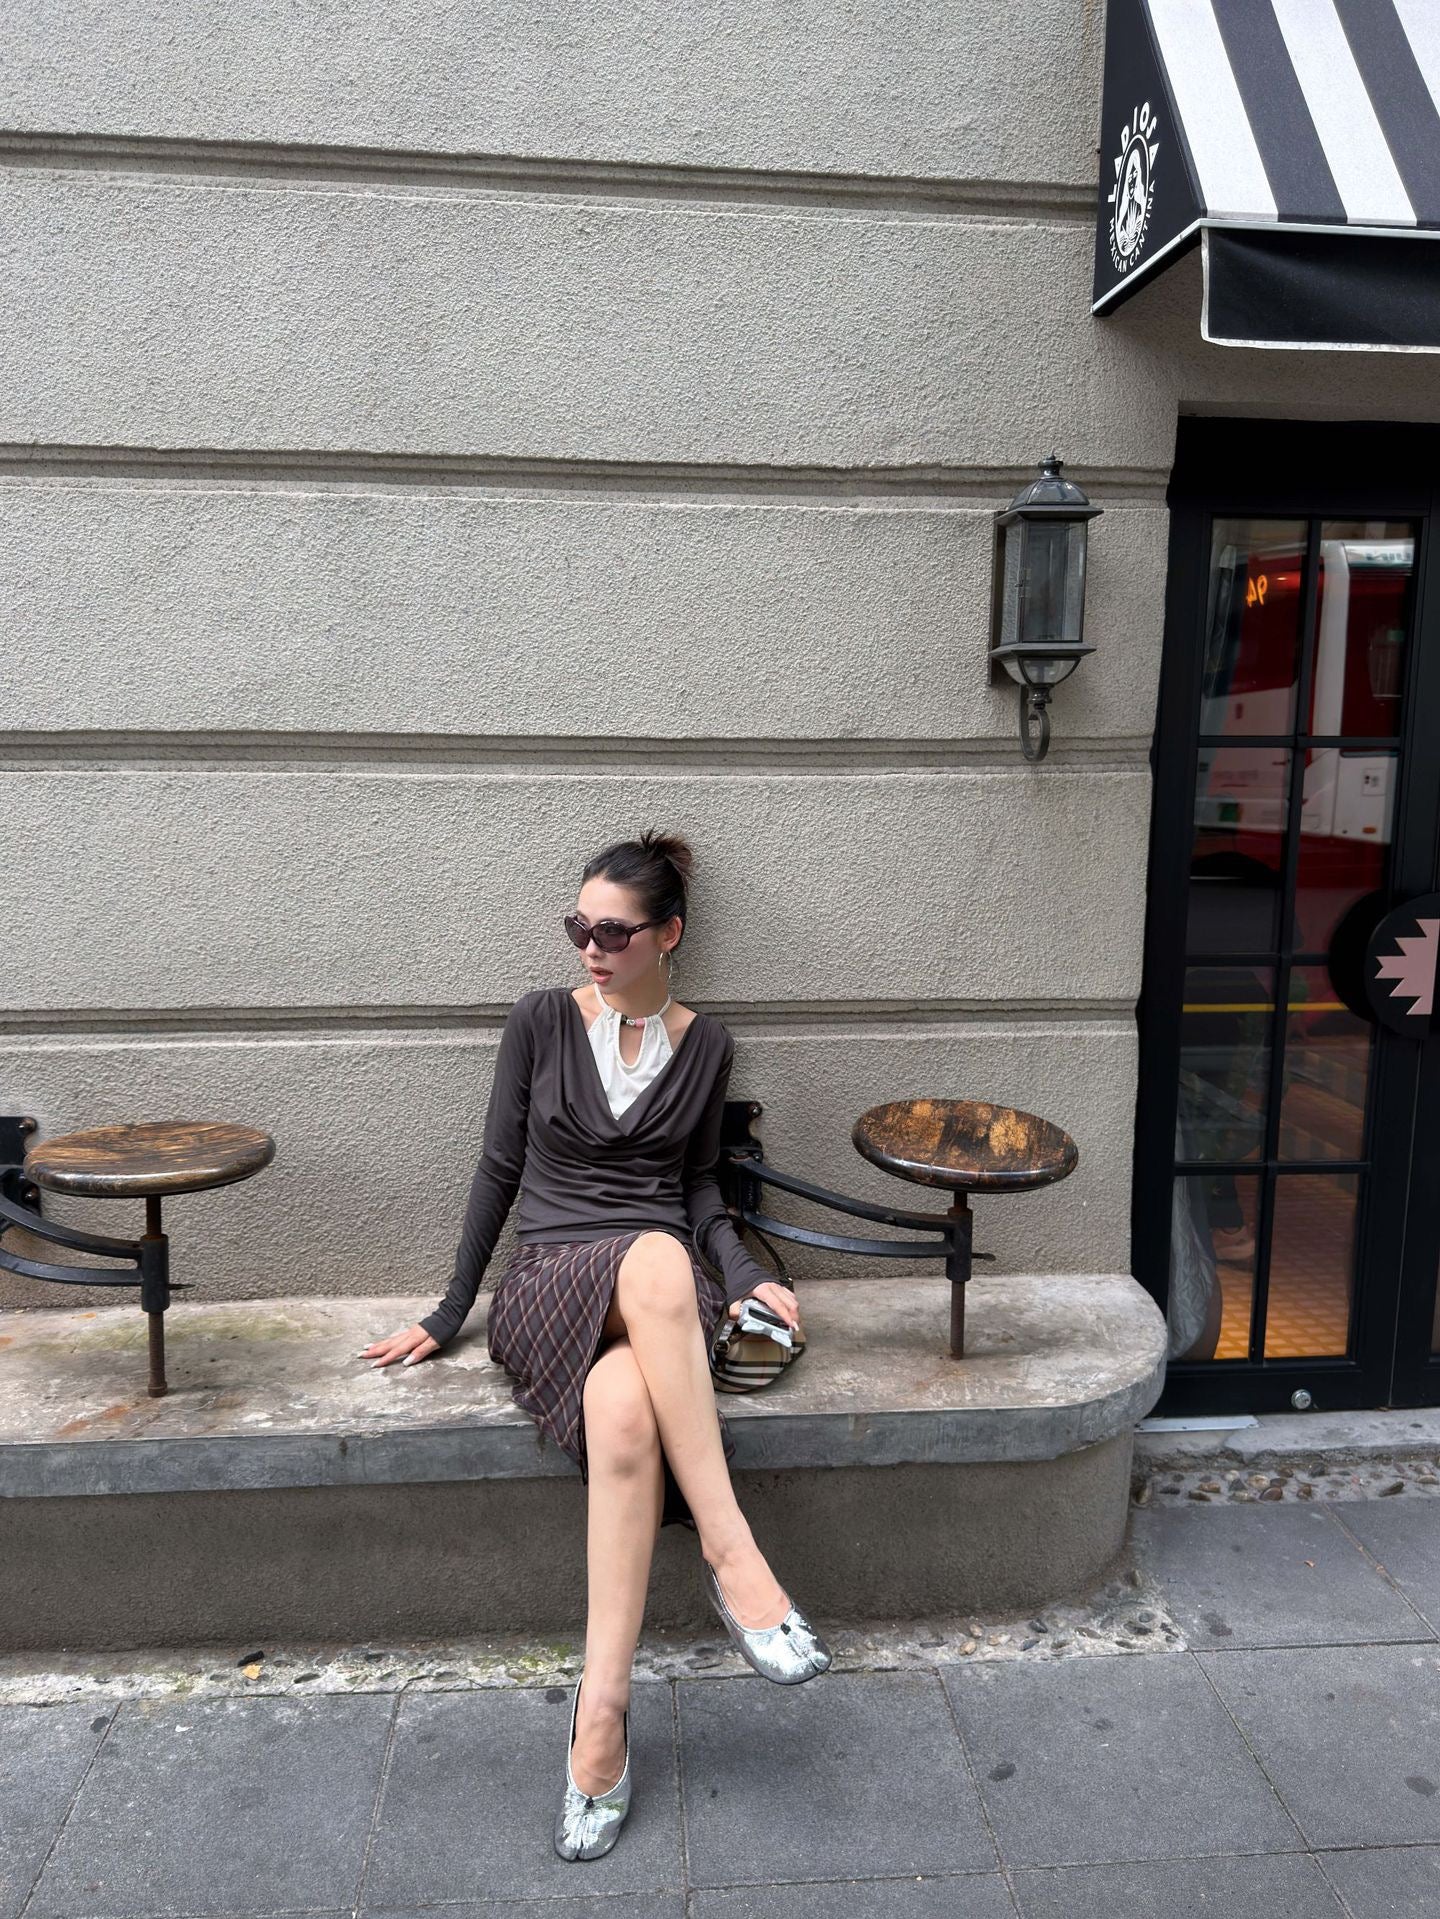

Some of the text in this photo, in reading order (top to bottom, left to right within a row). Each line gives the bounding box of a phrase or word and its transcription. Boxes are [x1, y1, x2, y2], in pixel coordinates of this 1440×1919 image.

[1107, 101, 1160, 203] LA DIOSA
[1108, 179, 1155, 273] MEXICAN CANTINA
